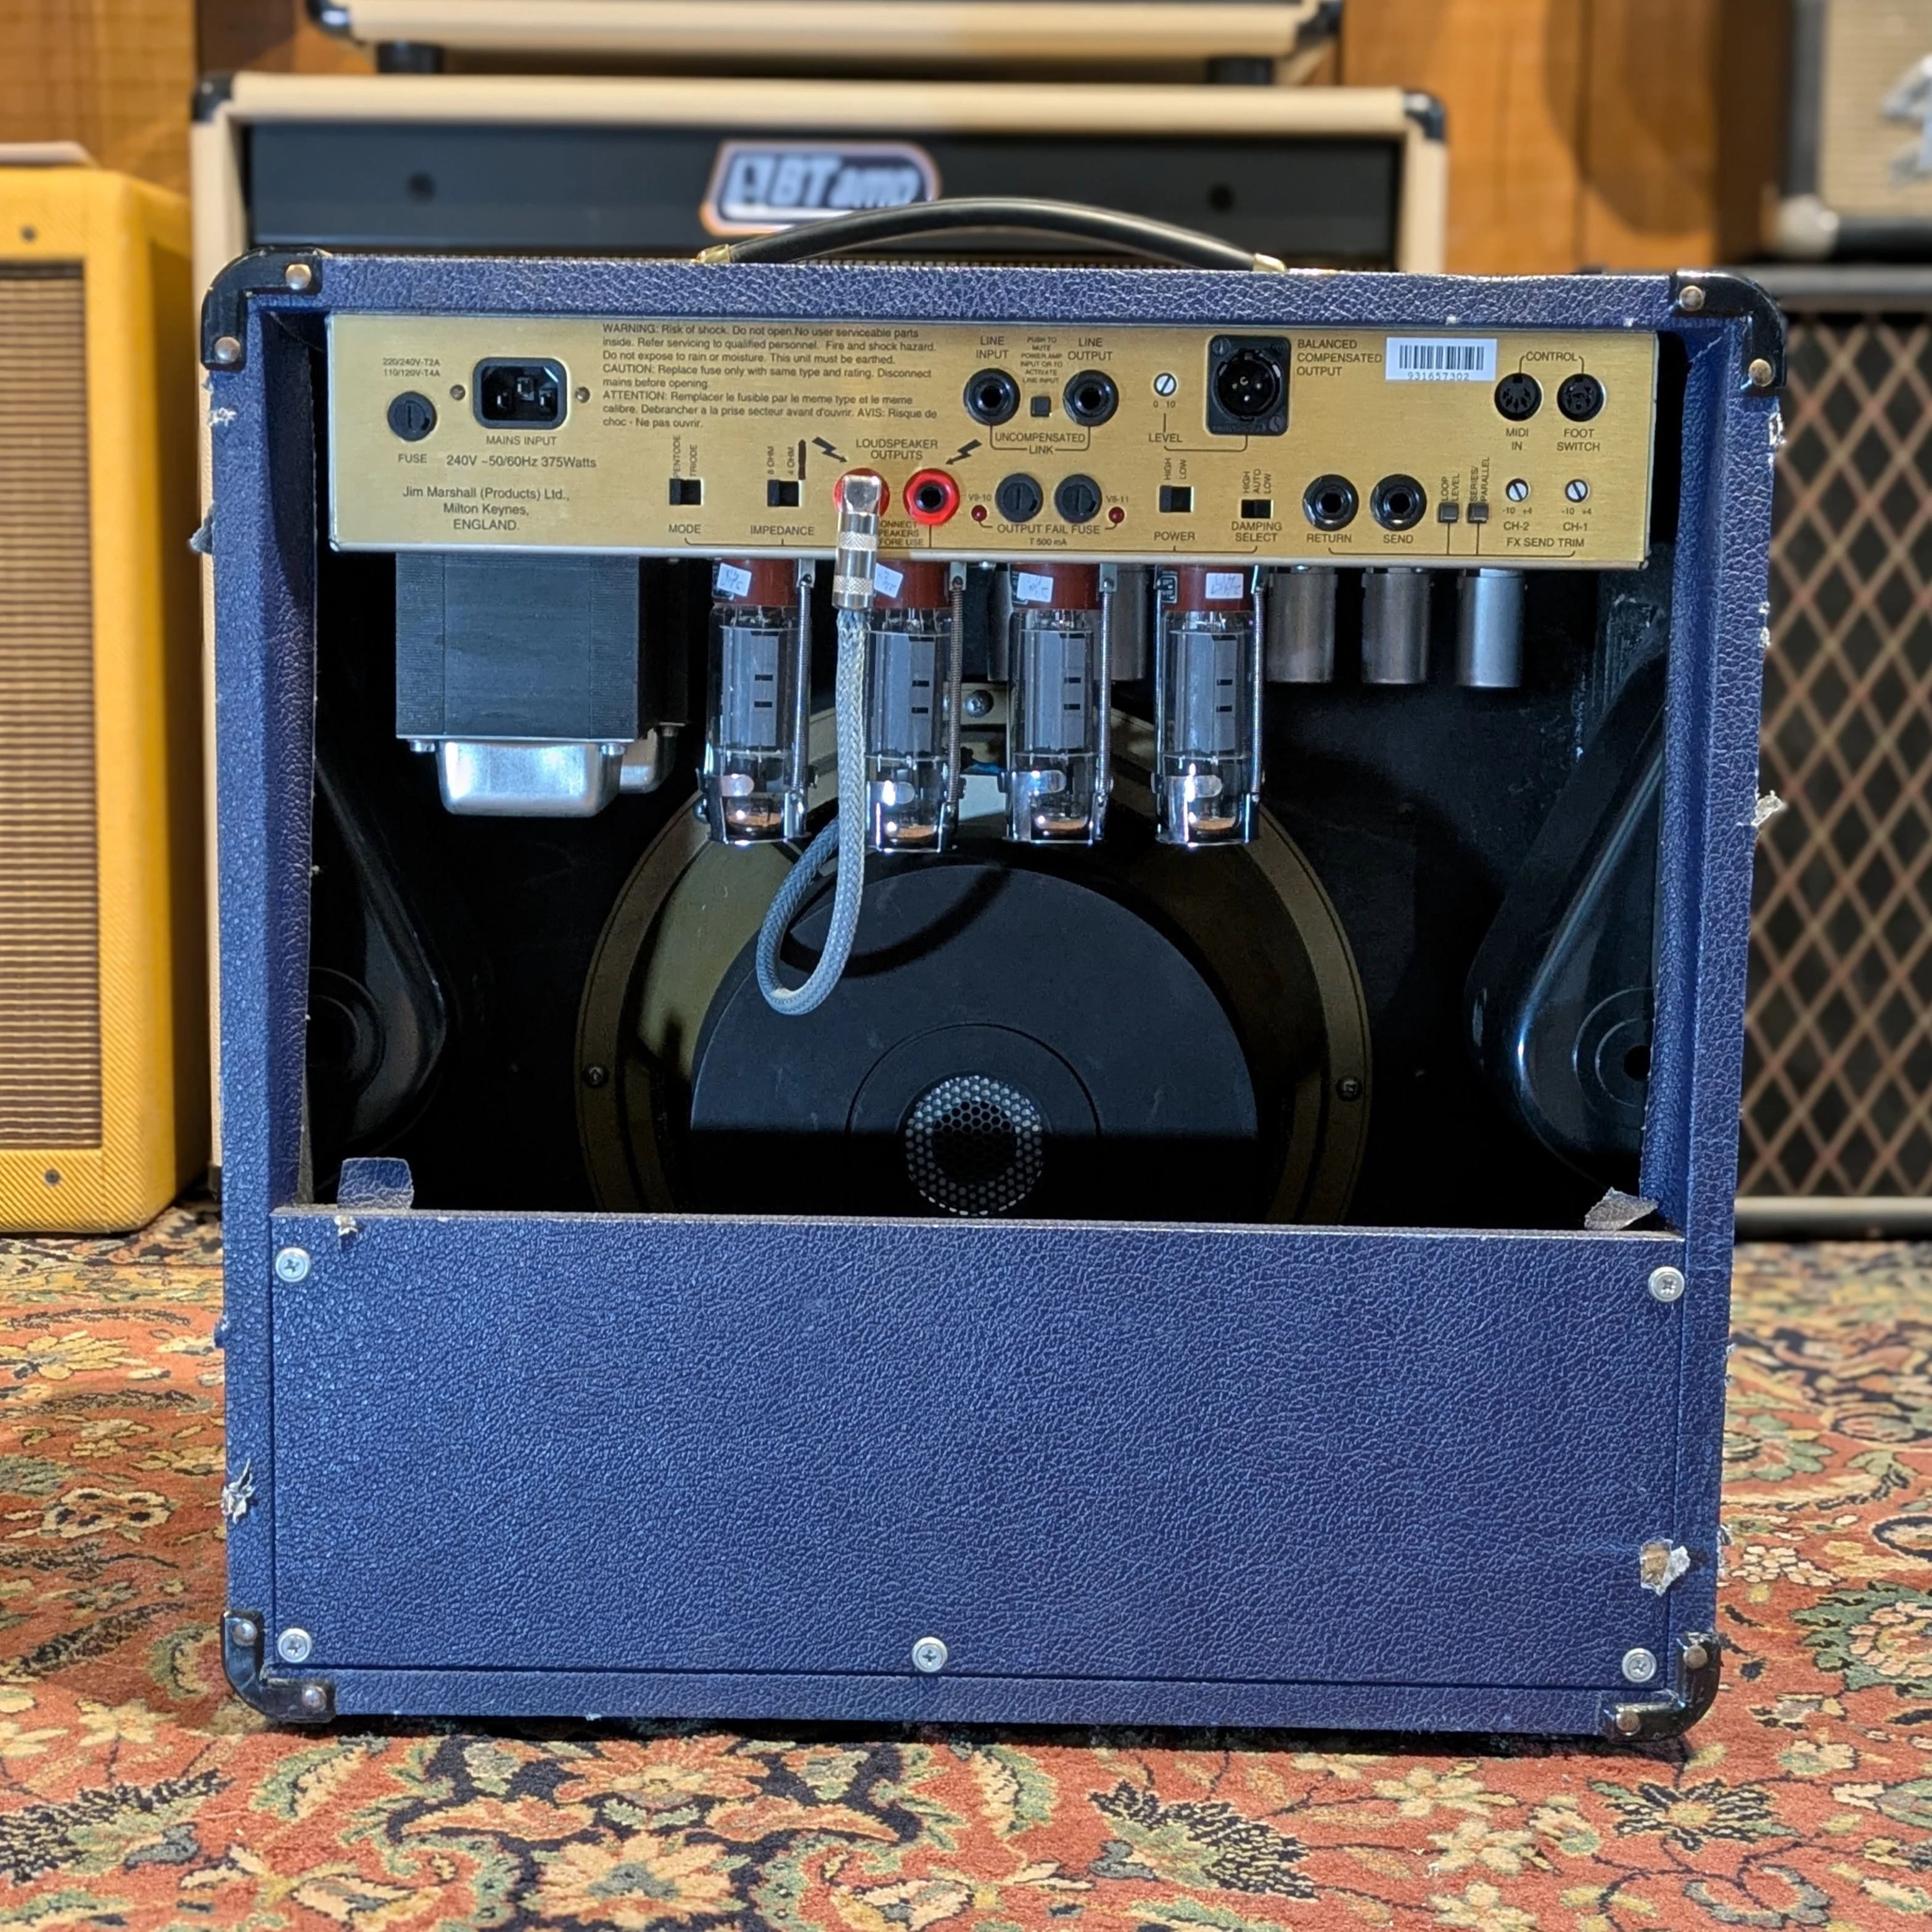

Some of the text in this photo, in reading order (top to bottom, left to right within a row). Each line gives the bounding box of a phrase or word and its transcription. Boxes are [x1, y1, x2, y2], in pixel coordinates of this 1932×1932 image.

[602, 323, 919, 339] WARNING: Risk of shock. Do not open.No user serviceable parts
[602, 337, 937, 353] inside. Refer servicing to qualified personnel. Fire and shock hazard.
[980, 336, 1005, 346] LINE
[1078, 337, 1103, 347] LINE
[1297, 339, 1357, 350] BALANCED
[602, 350, 895, 364] Do not expose to rain or moisture. This unit must be earthed.
[976, 350, 1009, 360] INPUT
[1067, 351, 1112, 361] OUTPUT
[1297, 353, 1383, 363] COMPENSATED
[1526, 352, 1577, 362] CONTROL
[382, 358, 440, 366] 220/240V-T2A
[384, 369, 440, 377] 110/120V-T4A
[602, 363, 932, 380] CAUTION: Replace fuse only with same type and rating. Disconnect
[1296, 366, 1342, 377] OUTPUT
[1408, 371, 1470, 380] 931657302
[602, 377, 709, 390] mains before opening
[602, 390, 913, 406] ATTENTION: Remplacer le fusible par le meme type et le meme
[1153, 400, 1176, 408] 0 10
[602, 404, 937, 419] calibre. Debrancher a la prise secteur avant d'ouvrir. AVIS: Risque de
[602, 417, 627, 426] choc
[636, 417, 650, 427] Ne
[652, 419, 670, 429] pas
[673, 418, 703, 428] ouvrir.
[995, 432, 1086, 443] UNCOMPENSATED
[1148, 433, 1183, 443] LEVEL
[1506, 428, 1529, 438] MIDI
[1564, 429, 1595, 438] FOOT
[485, 435, 557, 446] MAINS INPUT
[856, 438, 939, 450] LOUDSPEAKER
[1029, 445, 1053, 455] LINK
[1511, 442, 1523, 451] IN
[1557, 442, 1600, 452] SWITCH
[397, 453, 427, 463] FUSE
[673, 435, 681, 478] PENTODE
[689, 444, 697, 477] TRIODE
[767, 446, 775, 467] OHM
[870, 450, 923, 461] OUTPUTS
[446, 455, 477, 466] 240V
[541, 456, 596, 468] 375Watts
[1179, 459, 1187, 479] LOW
[1243, 471, 1251, 493] HIGH
[1264, 473, 1272, 493] LOW
[1470, 466, 1479, 502] SERIES/
[1481, 456, 1490, 502] PARALLEL
[1441, 476, 1449, 501] LOOP
[1451, 473, 1460, 501] LEVEL
[403, 486, 570, 501] Jim Marshall (Products) Ltd.,
[969, 493, 992, 502] V9-10
[1106, 495, 1129, 504] V8-11
[443, 503, 529, 517] Milton Keynes,
[1561, 507, 1592, 515] -10 +4
[453, 519, 520, 531] ENGLAND.
[668, 524, 701, 534] MODE
[880, 520, 918, 528] ONNECT
[997, 524, 1100, 535] OUTPUT FAIL FUSE
[1231, 520, 1282, 532] DAMPING
[1503, 522, 1530, 531] CH-2
[1563, 522, 1589, 531] CH-1
[750, 525, 815, 536] IMPEDANCE
[878, 529, 919, 537] PEAKERS
[1154, 531, 1195, 541] POWER
[879, 538, 903, 546] FORE
[1029, 538, 1067, 546] T 500 mA
[1235, 532, 1277, 543] SELECT
[1307, 533, 1352, 543] RETURN
[1383, 534, 1413, 544] SEND
[1507, 538, 1584, 548] FX SEND TRIM
